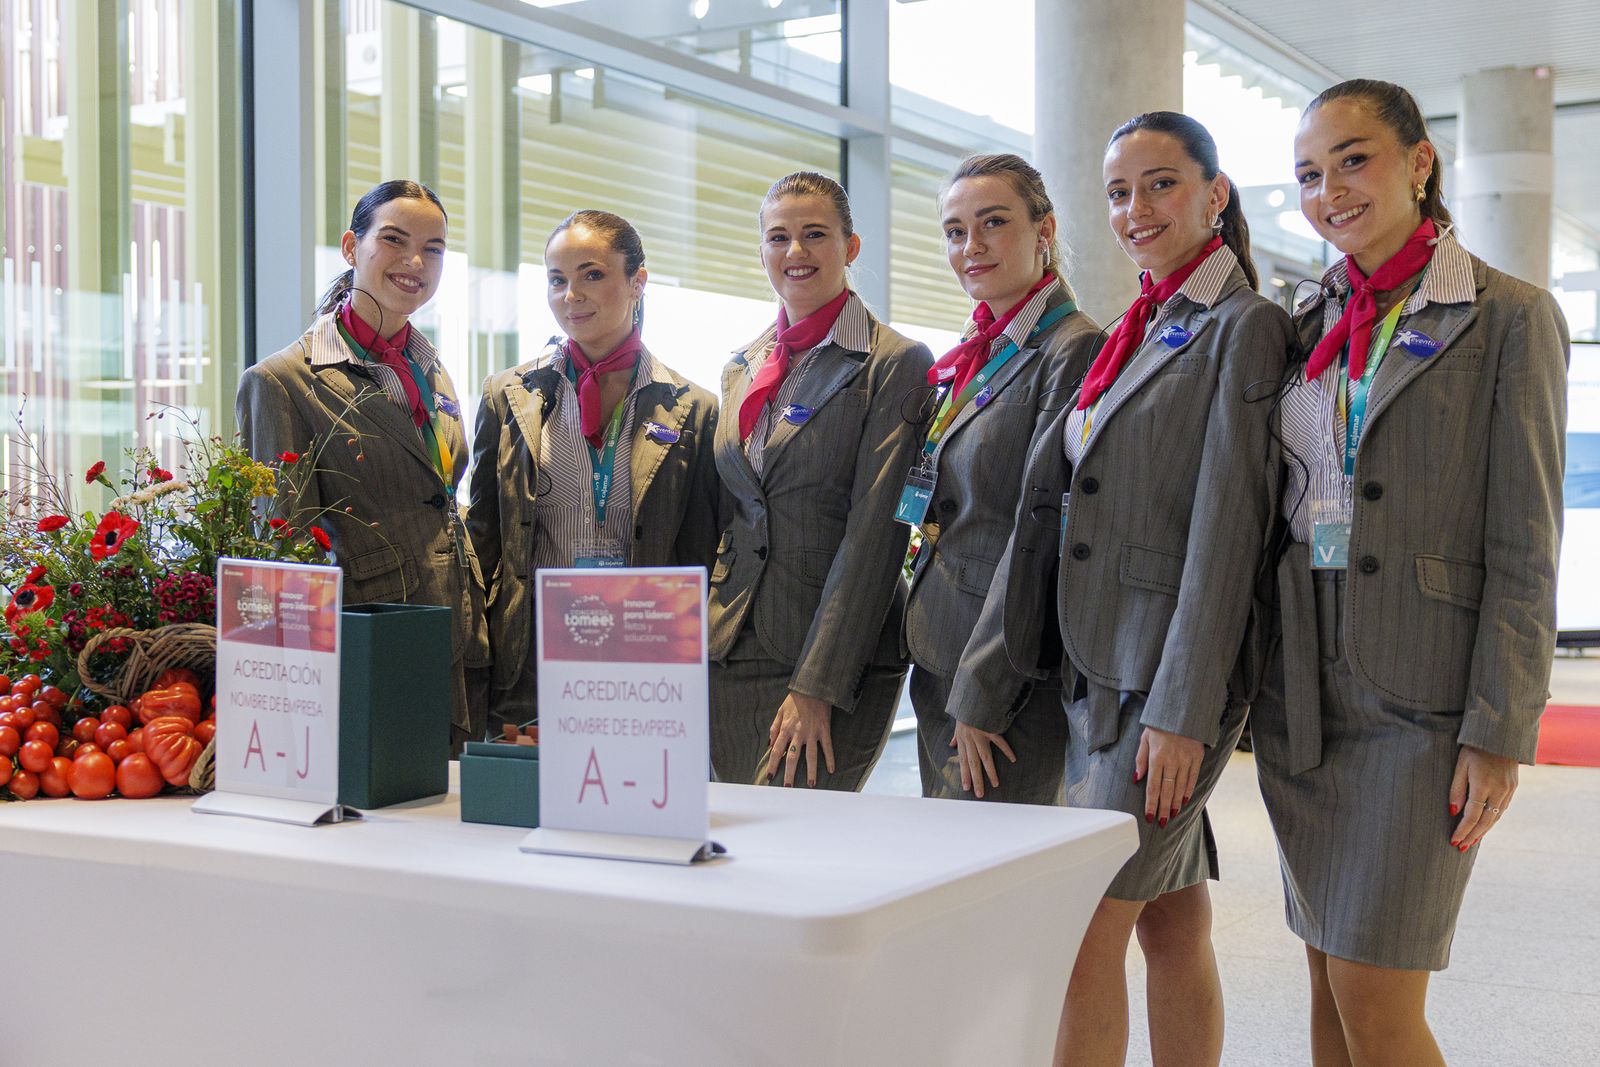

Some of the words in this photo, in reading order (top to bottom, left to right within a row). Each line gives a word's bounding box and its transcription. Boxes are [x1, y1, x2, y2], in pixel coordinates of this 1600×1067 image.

[1351, 414, 1360, 446] cajamar
[601, 474, 609, 499] cajamar
[899, 502, 908, 516] V
[1318, 545, 1336, 563] V
[237, 599, 273, 616] tomeet
[623, 599, 656, 608] Innovar
[564, 613, 615, 627] tomeet
[623, 612, 643, 621] para
[233, 659, 321, 685] ACREDITACIÓN
[562, 676, 682, 703] ACREDITACIÓN
[230, 691, 268, 711] NOMBRE
[270, 695, 281, 712] DE
[283, 697, 324, 717] EMPRESA
[558, 716, 609, 735] NOMBRE
[613, 718, 629, 736] DE
[631, 719, 687, 738] EMPRESA
[243, 719, 266, 772] A
[296, 726, 309, 780] J
[578, 747, 608, 805] A
[652, 749, 668, 809] J
